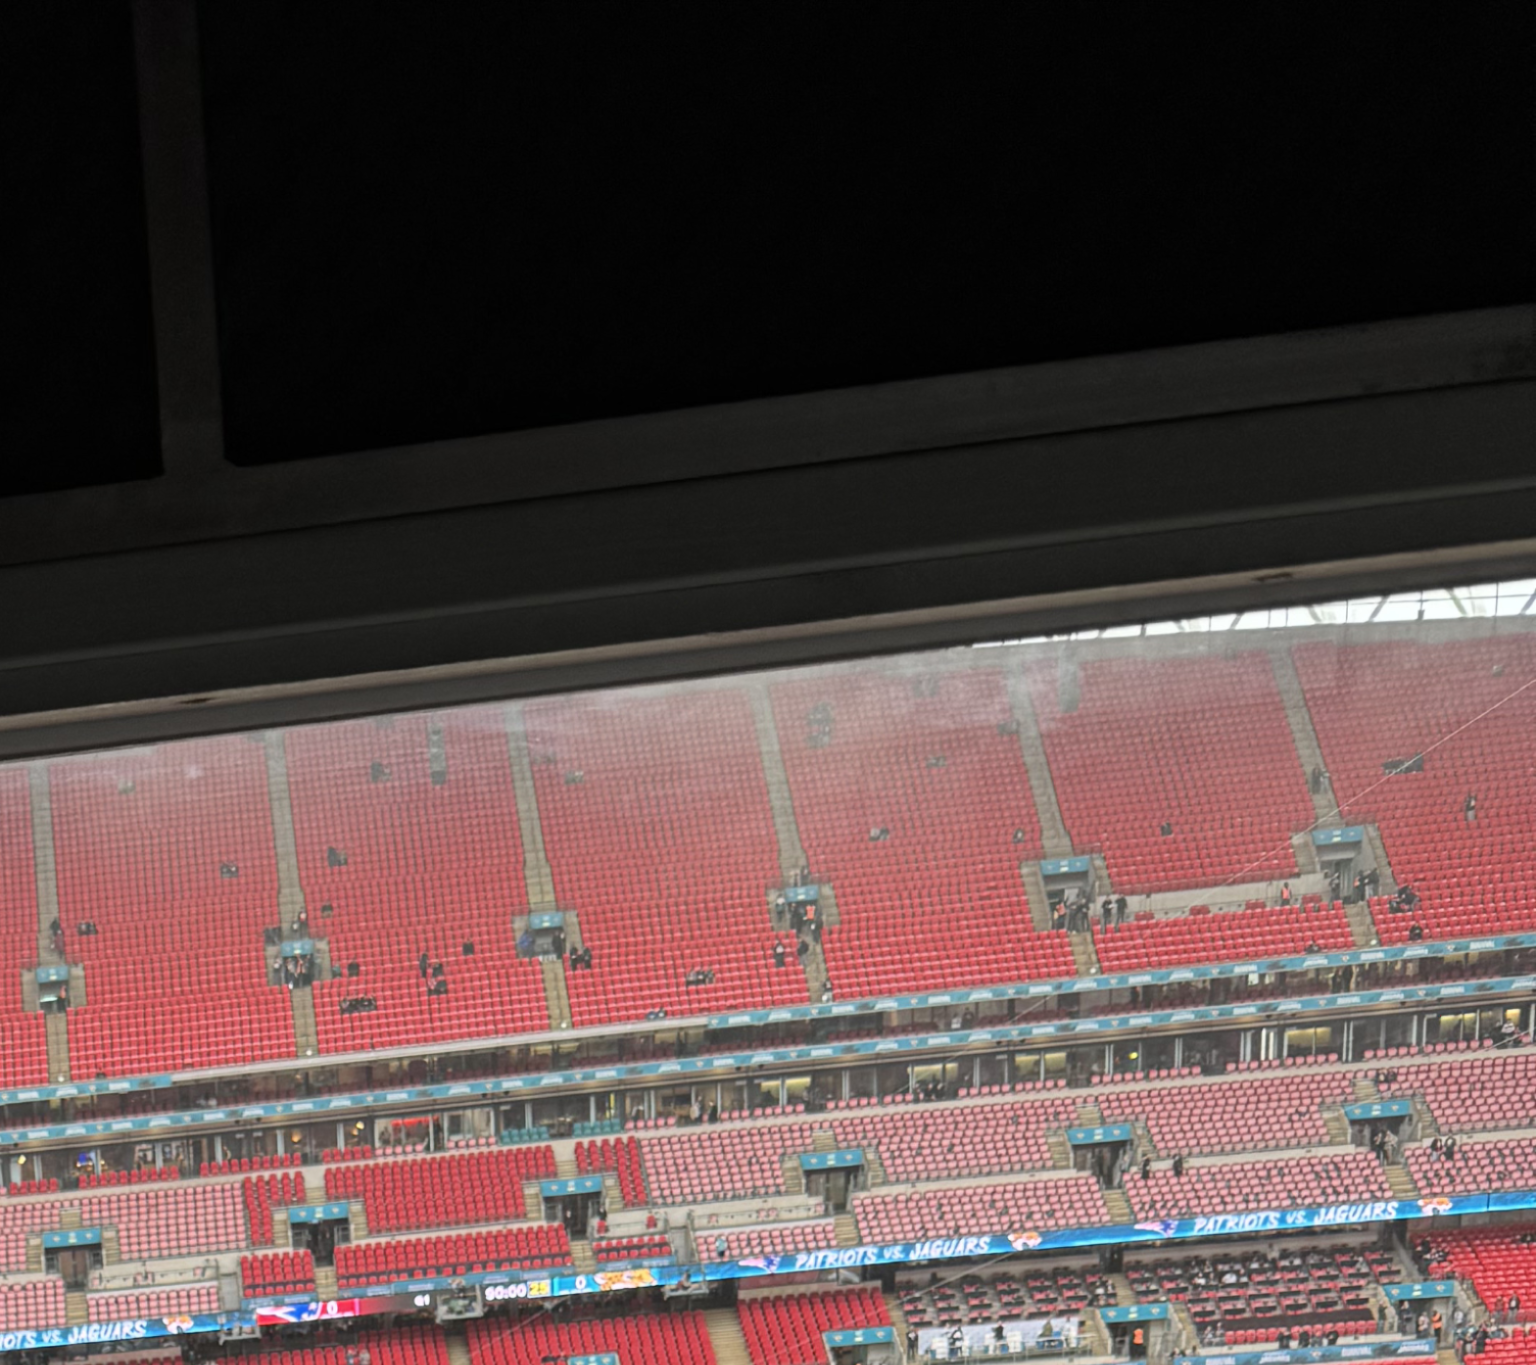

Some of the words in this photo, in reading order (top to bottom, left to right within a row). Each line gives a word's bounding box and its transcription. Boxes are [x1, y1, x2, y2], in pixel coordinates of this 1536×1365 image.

[1193, 1210, 1280, 1233] PATRIOTS
[1314, 1202, 1398, 1224] JAGUARS
[795, 1246, 878, 1269] PATRIOTS
[909, 1237, 991, 1260] JAGUARS
[68, 1320, 147, 1343] JAGUARS
